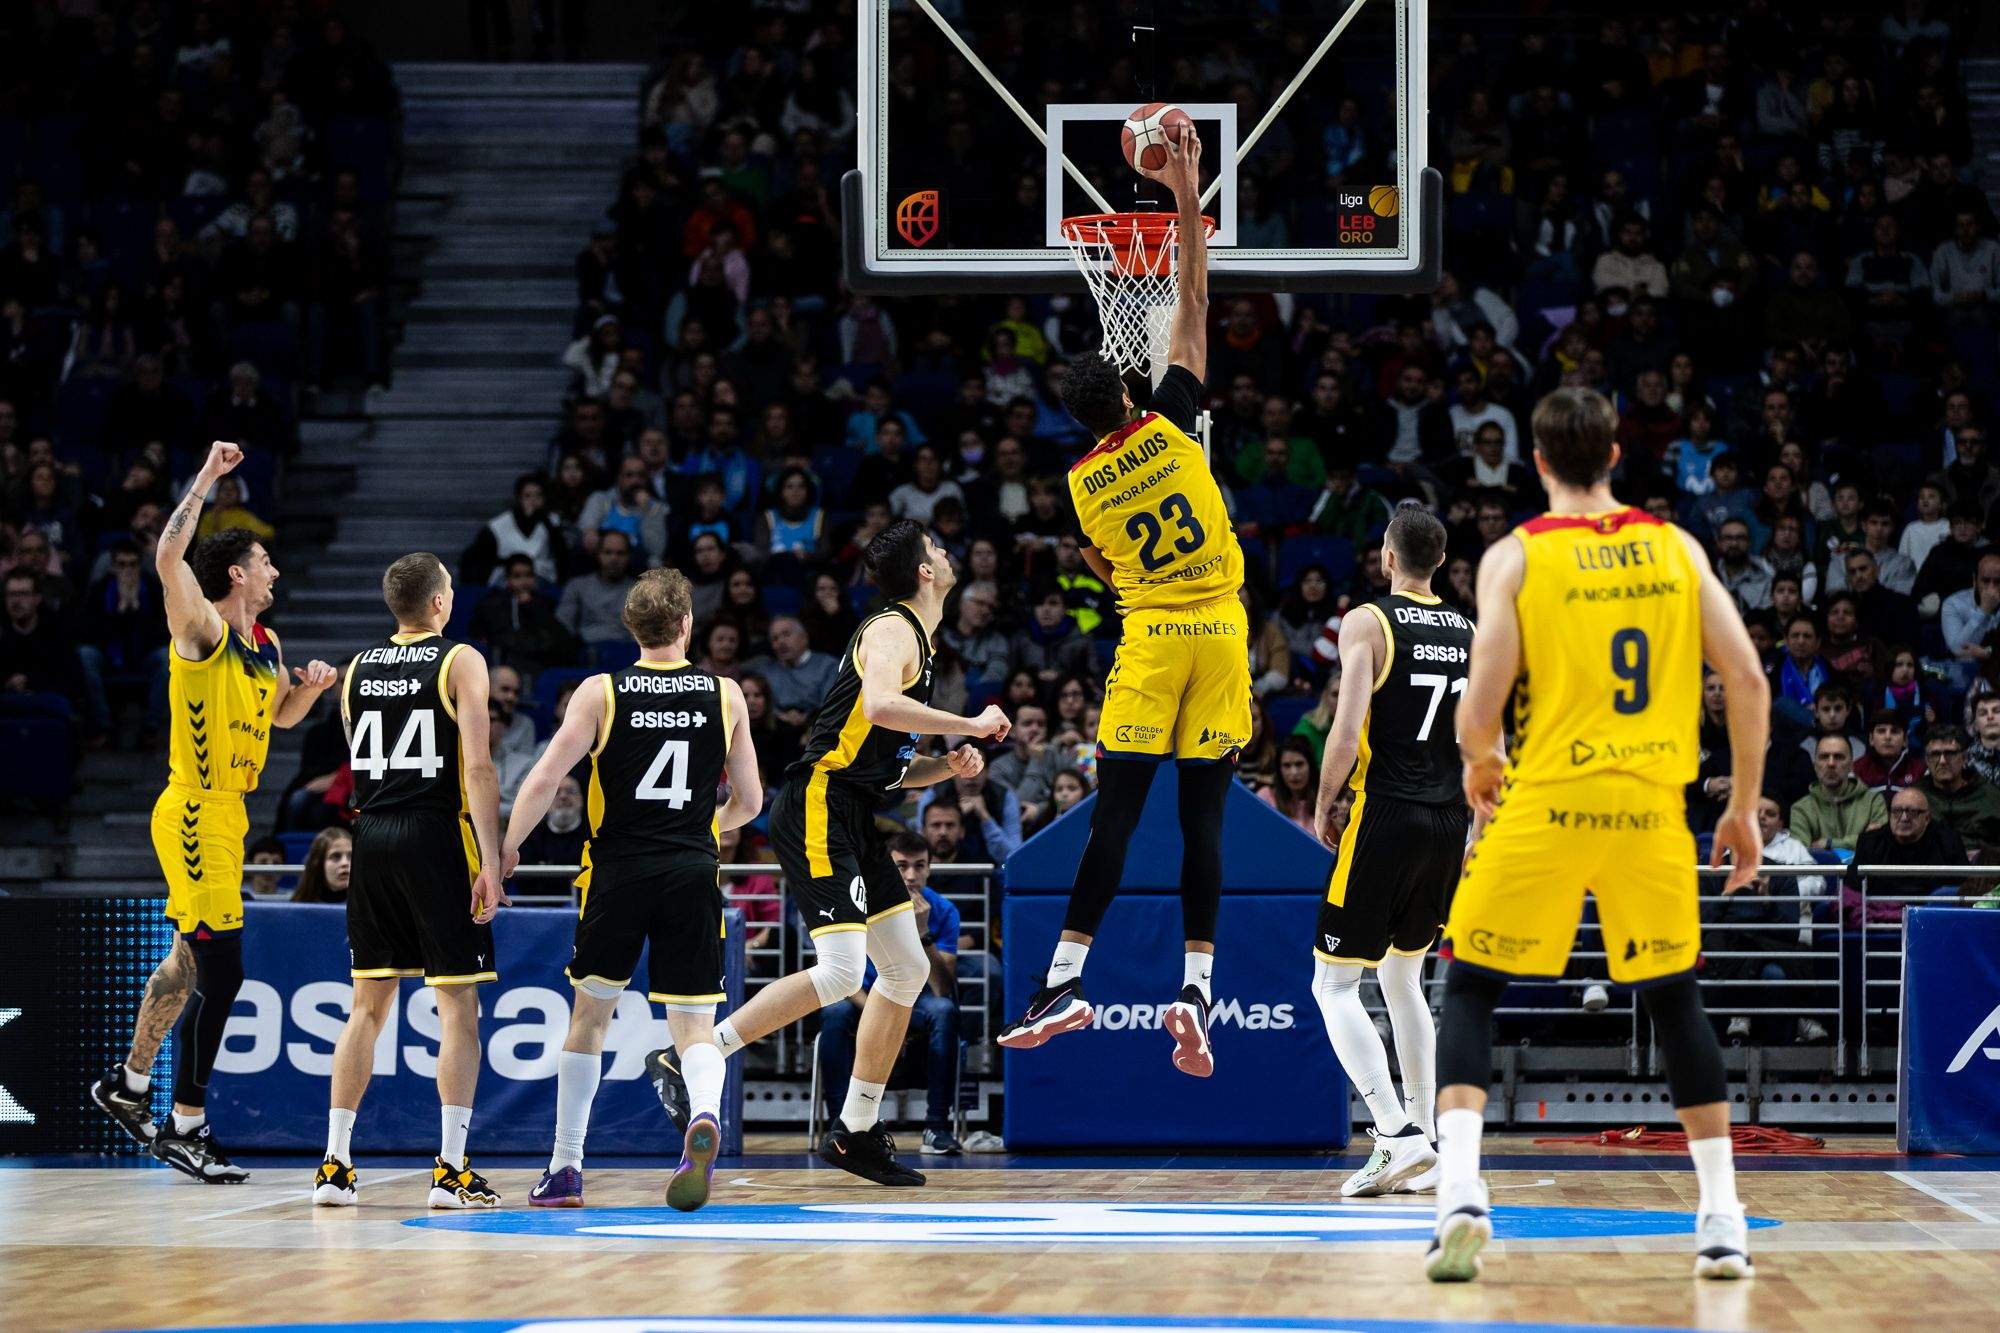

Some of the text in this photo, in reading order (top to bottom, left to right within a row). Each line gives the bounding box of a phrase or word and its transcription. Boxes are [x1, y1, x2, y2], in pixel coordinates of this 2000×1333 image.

[1340, 193, 1363, 208] Liga
[1340, 214, 1376, 230] LEB
[1340, 231, 1373, 243] ORO
[1082, 431, 1169, 496] DOS ANJOS
[1110, 459, 1181, 507] MORABANC
[1125, 492, 1206, 572] 23
[1575, 541, 1655, 570] LLOVET
[1394, 607, 1468, 630] DEMETRIO
[361, 646, 439, 664] LEIMANIS
[1611, 627, 1649, 715] 9
[619, 675, 716, 694] JORGENSEN
[1134, 725, 1164, 734] GOLDEN
[1134, 732, 1157, 740] TULIP
[1218, 731, 1231, 739] PAL
[350, 709, 444, 780] 44
[635, 740, 693, 811] 4
